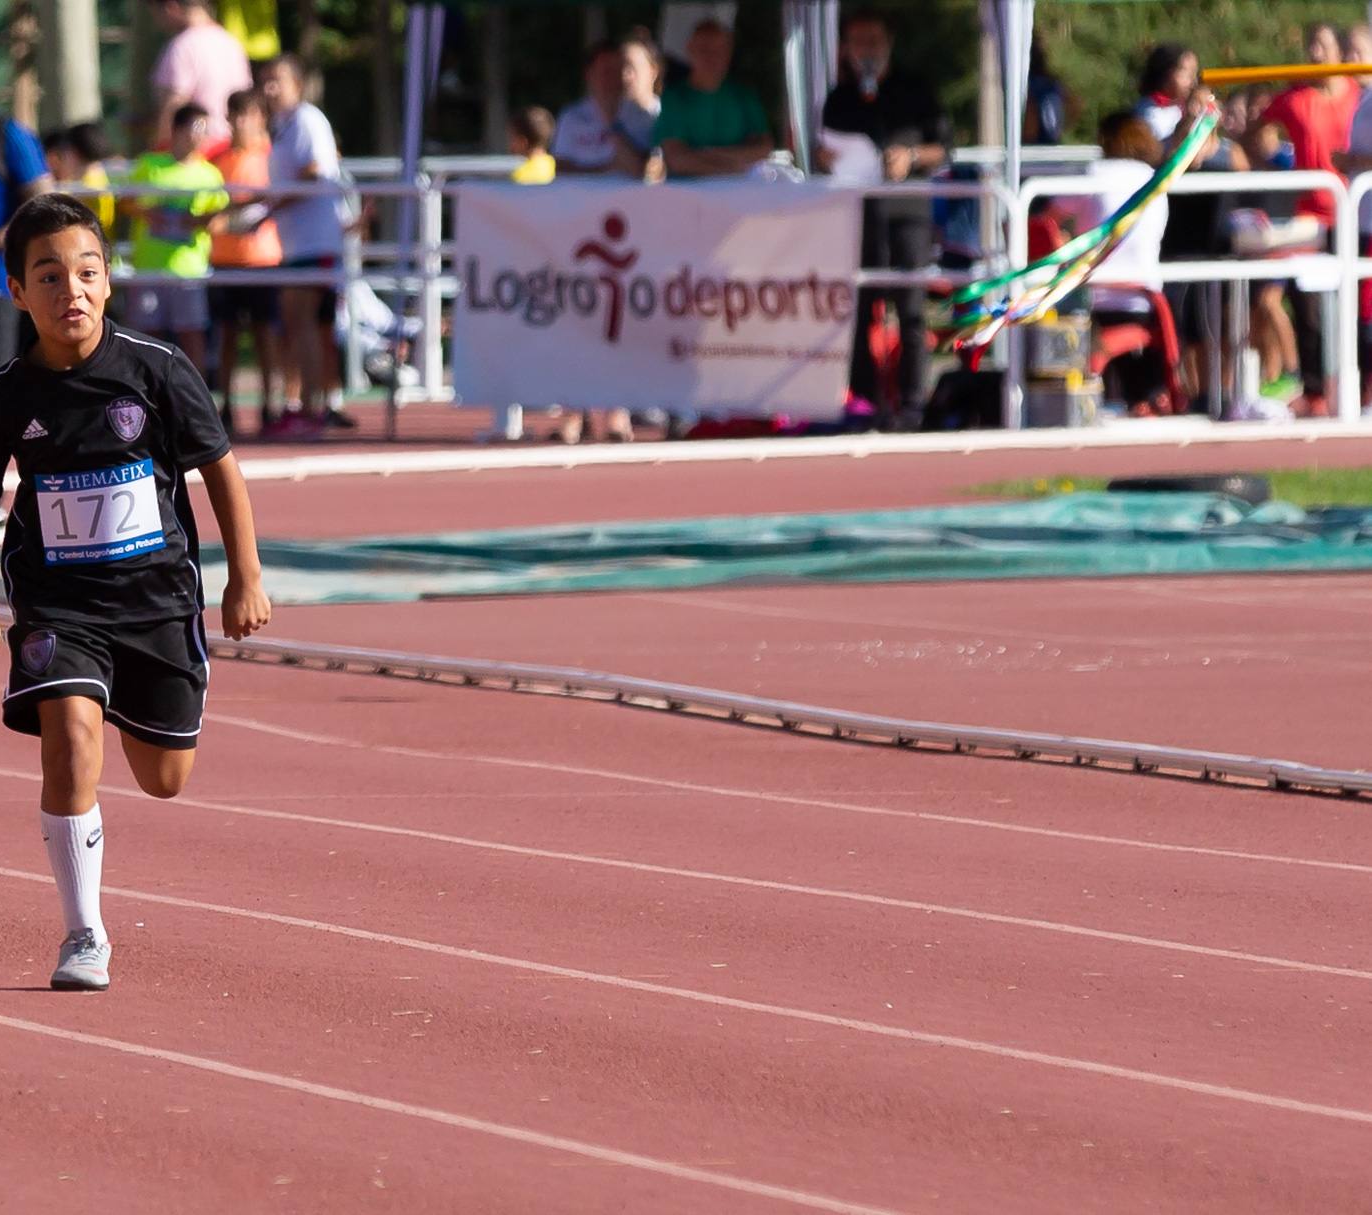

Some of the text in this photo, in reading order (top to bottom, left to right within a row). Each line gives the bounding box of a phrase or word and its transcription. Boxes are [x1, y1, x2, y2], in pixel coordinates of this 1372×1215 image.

[662, 262, 853, 334] deporte
[67, 462, 147, 490] HEMAFIX
[50, 489, 140, 541] 172
[58, 550, 85, 560] Central
[125, 543, 135, 552] de
